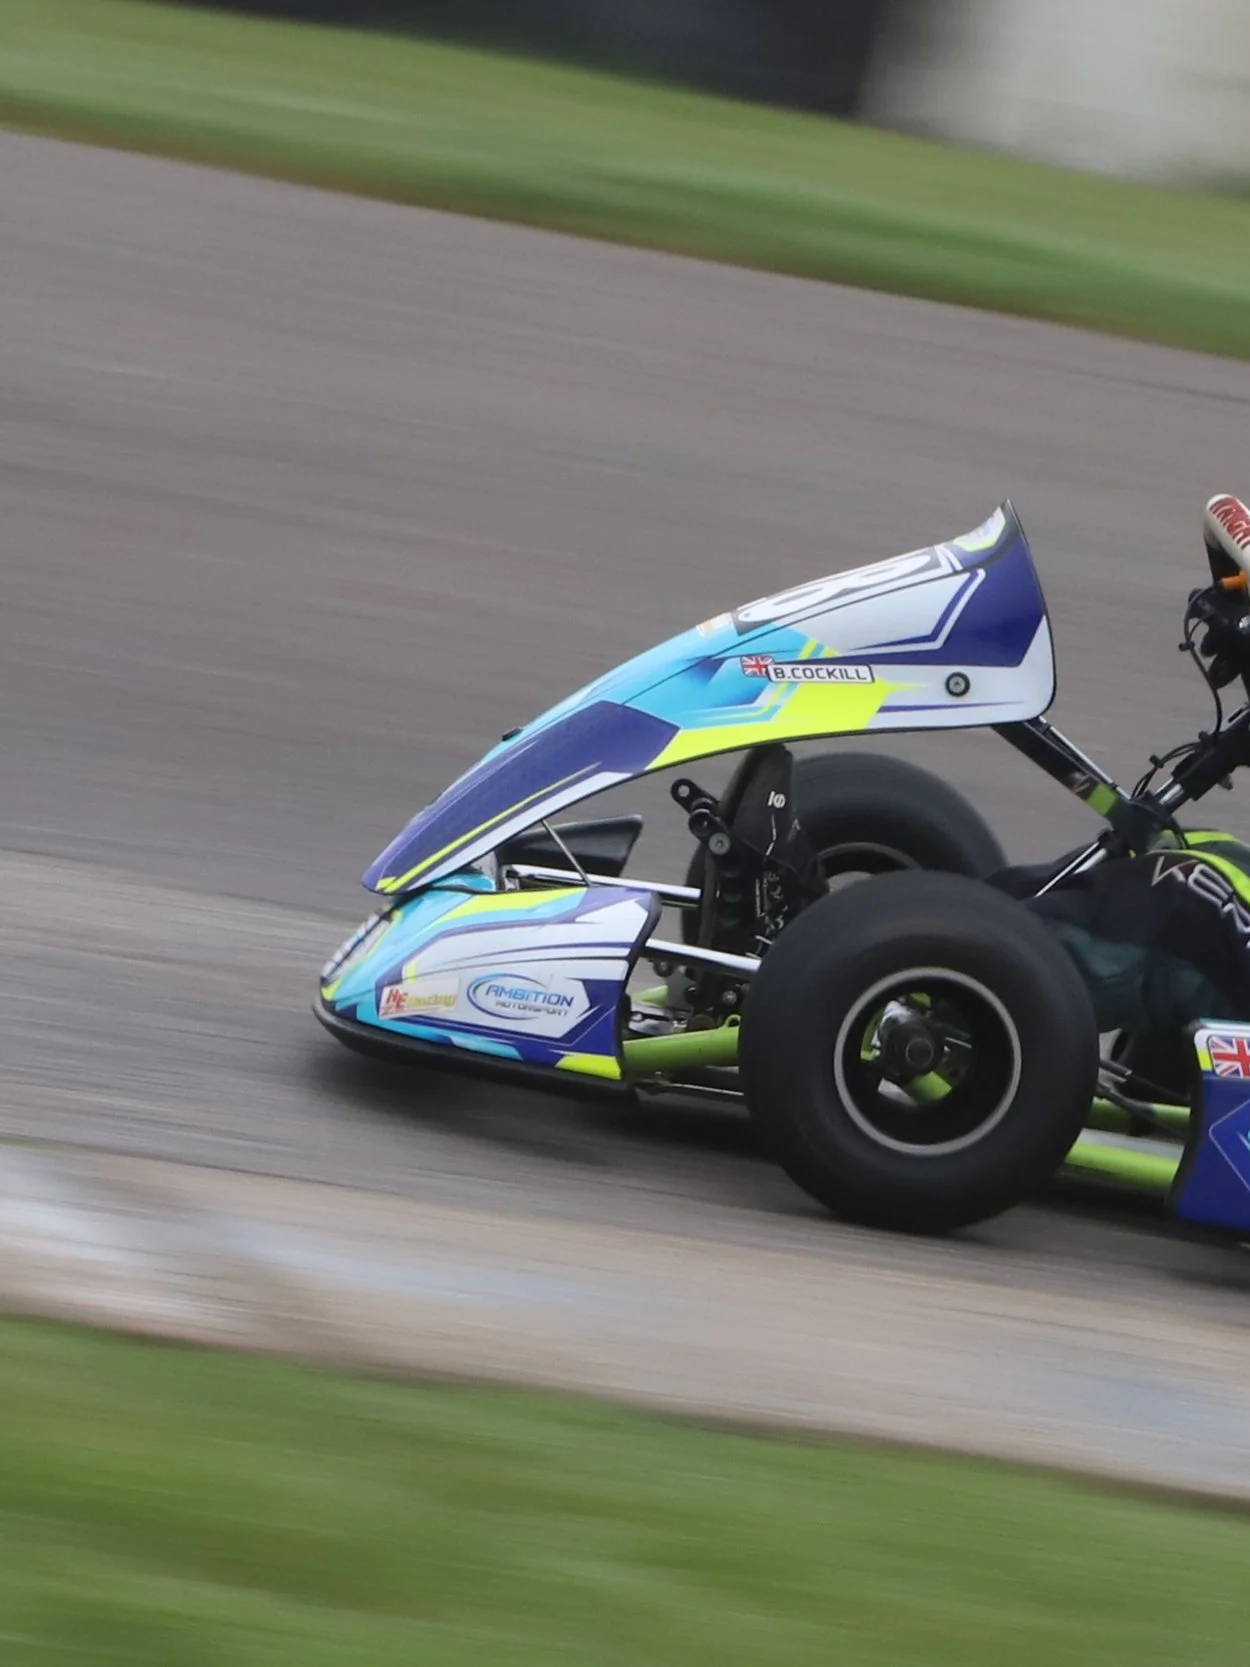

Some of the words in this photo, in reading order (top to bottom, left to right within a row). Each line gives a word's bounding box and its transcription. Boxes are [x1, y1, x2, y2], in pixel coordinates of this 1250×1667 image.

[773, 666, 868, 681] B.COCKILL
[485, 984, 575, 1008] AMBITION
[496, 1001, 569, 1017] MOTORSPORT
